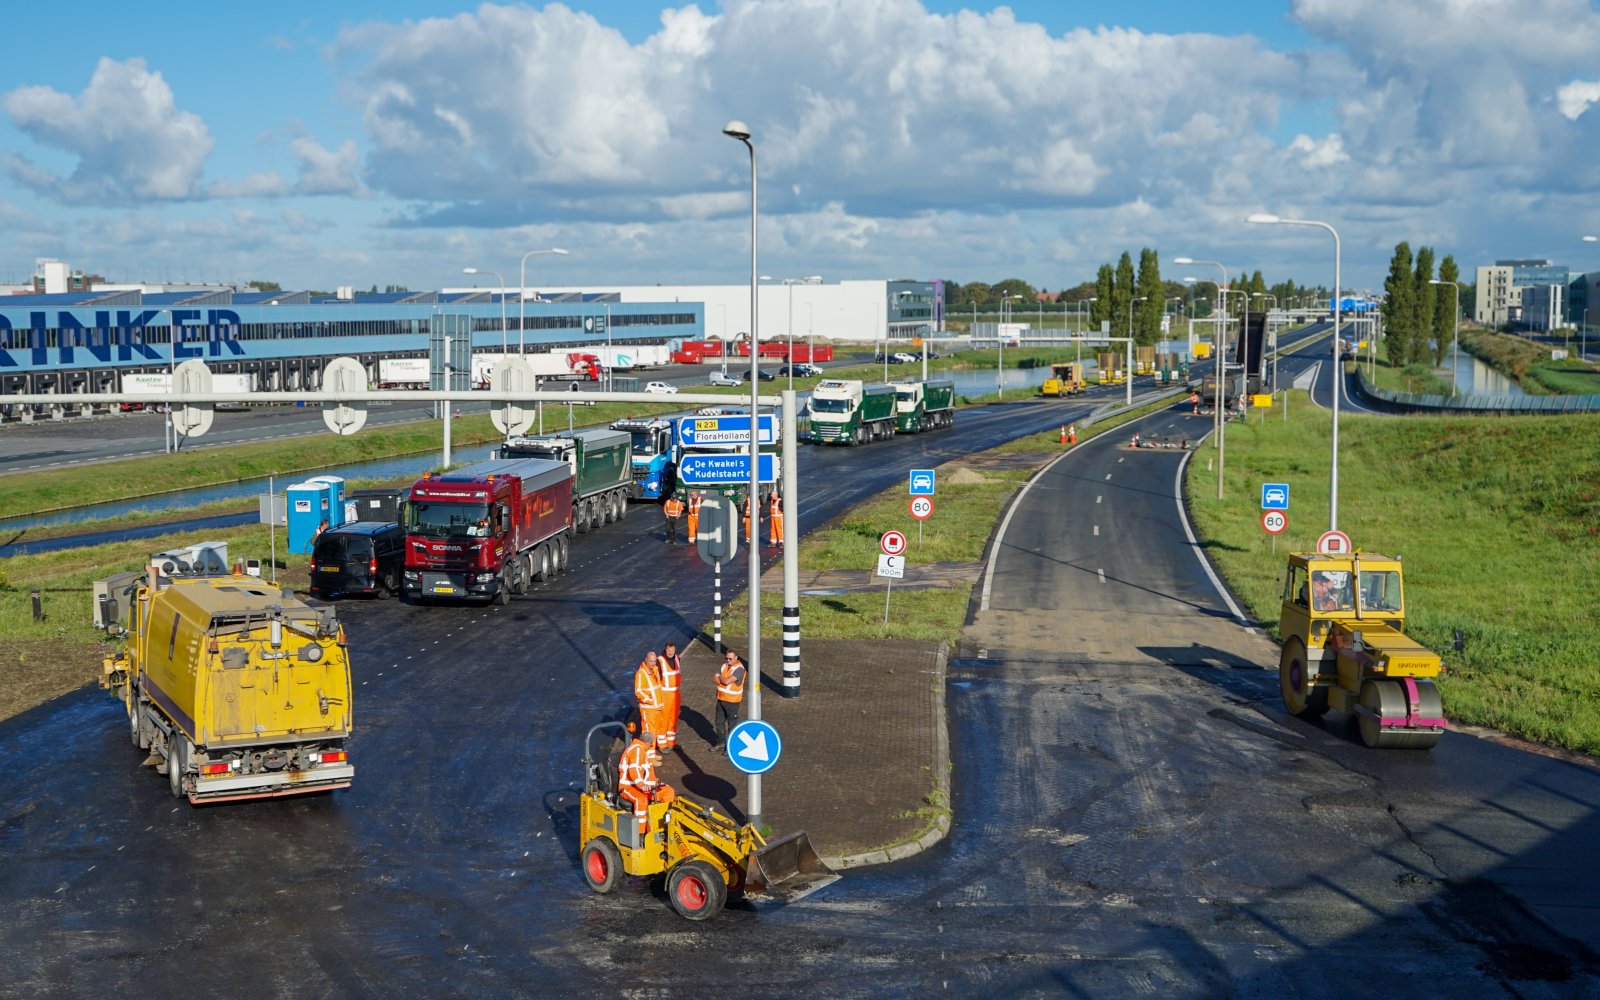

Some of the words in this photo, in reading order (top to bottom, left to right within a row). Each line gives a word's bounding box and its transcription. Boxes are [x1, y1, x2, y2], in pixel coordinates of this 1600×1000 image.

[696, 432, 750, 440] FloraHolland
[695, 460, 706, 468] De
[708, 460, 738, 468] Kwakel
[695, 470, 744, 478] Kudelstaart
[914, 502, 930, 511] 80
[1267, 516, 1283, 526] 80
[887, 556, 895, 567] C
[880, 568, 901, 576] 900m
